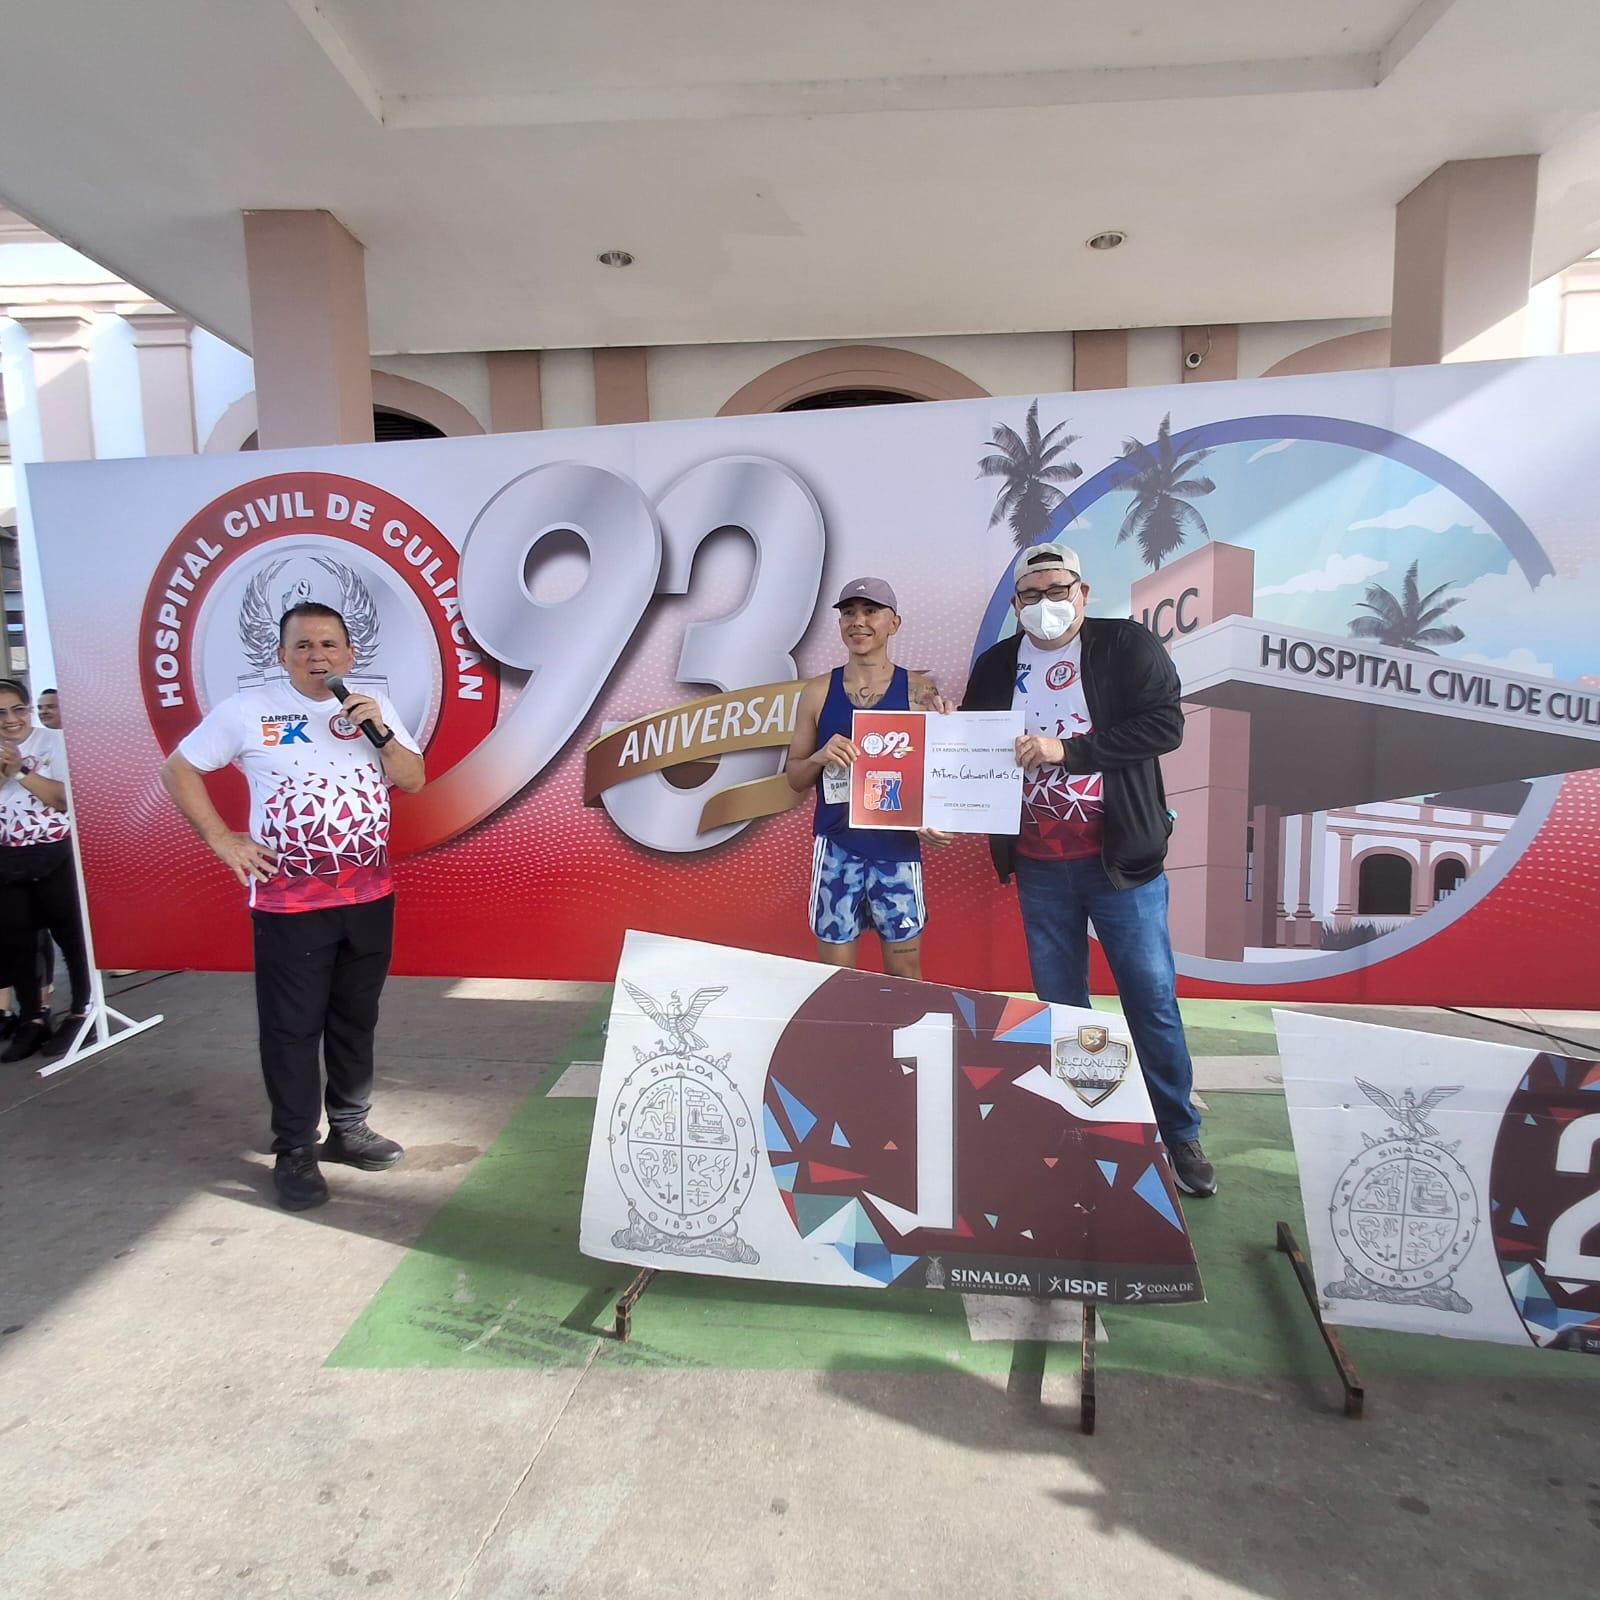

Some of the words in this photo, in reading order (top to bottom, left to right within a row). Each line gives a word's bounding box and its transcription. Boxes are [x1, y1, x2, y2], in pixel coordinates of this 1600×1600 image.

[155, 536, 223, 707] HOSPITAL
[223, 491, 315, 538] CIVIL
[326, 493, 376, 531] DE
[396, 455, 827, 853] 93
[1261, 635, 1421, 694] HOSPITAL
[1428, 669, 1499, 708] CIVIL
[1504, 683, 1542, 715] DE
[260, 714, 309, 723] CARRERA
[651, 1063, 714, 1081] SINALOA
[893, 1012, 953, 1229] 1
[1378, 1145, 1442, 1162] SINALOA
[665, 1217, 701, 1230] 1831
[951, 1269, 1031, 1287] SINALOA
[1065, 1278, 1108, 1297] ISDE
[1147, 1282, 1194, 1294] CONADE
[1381, 1272, 1417, 1283] 1831
